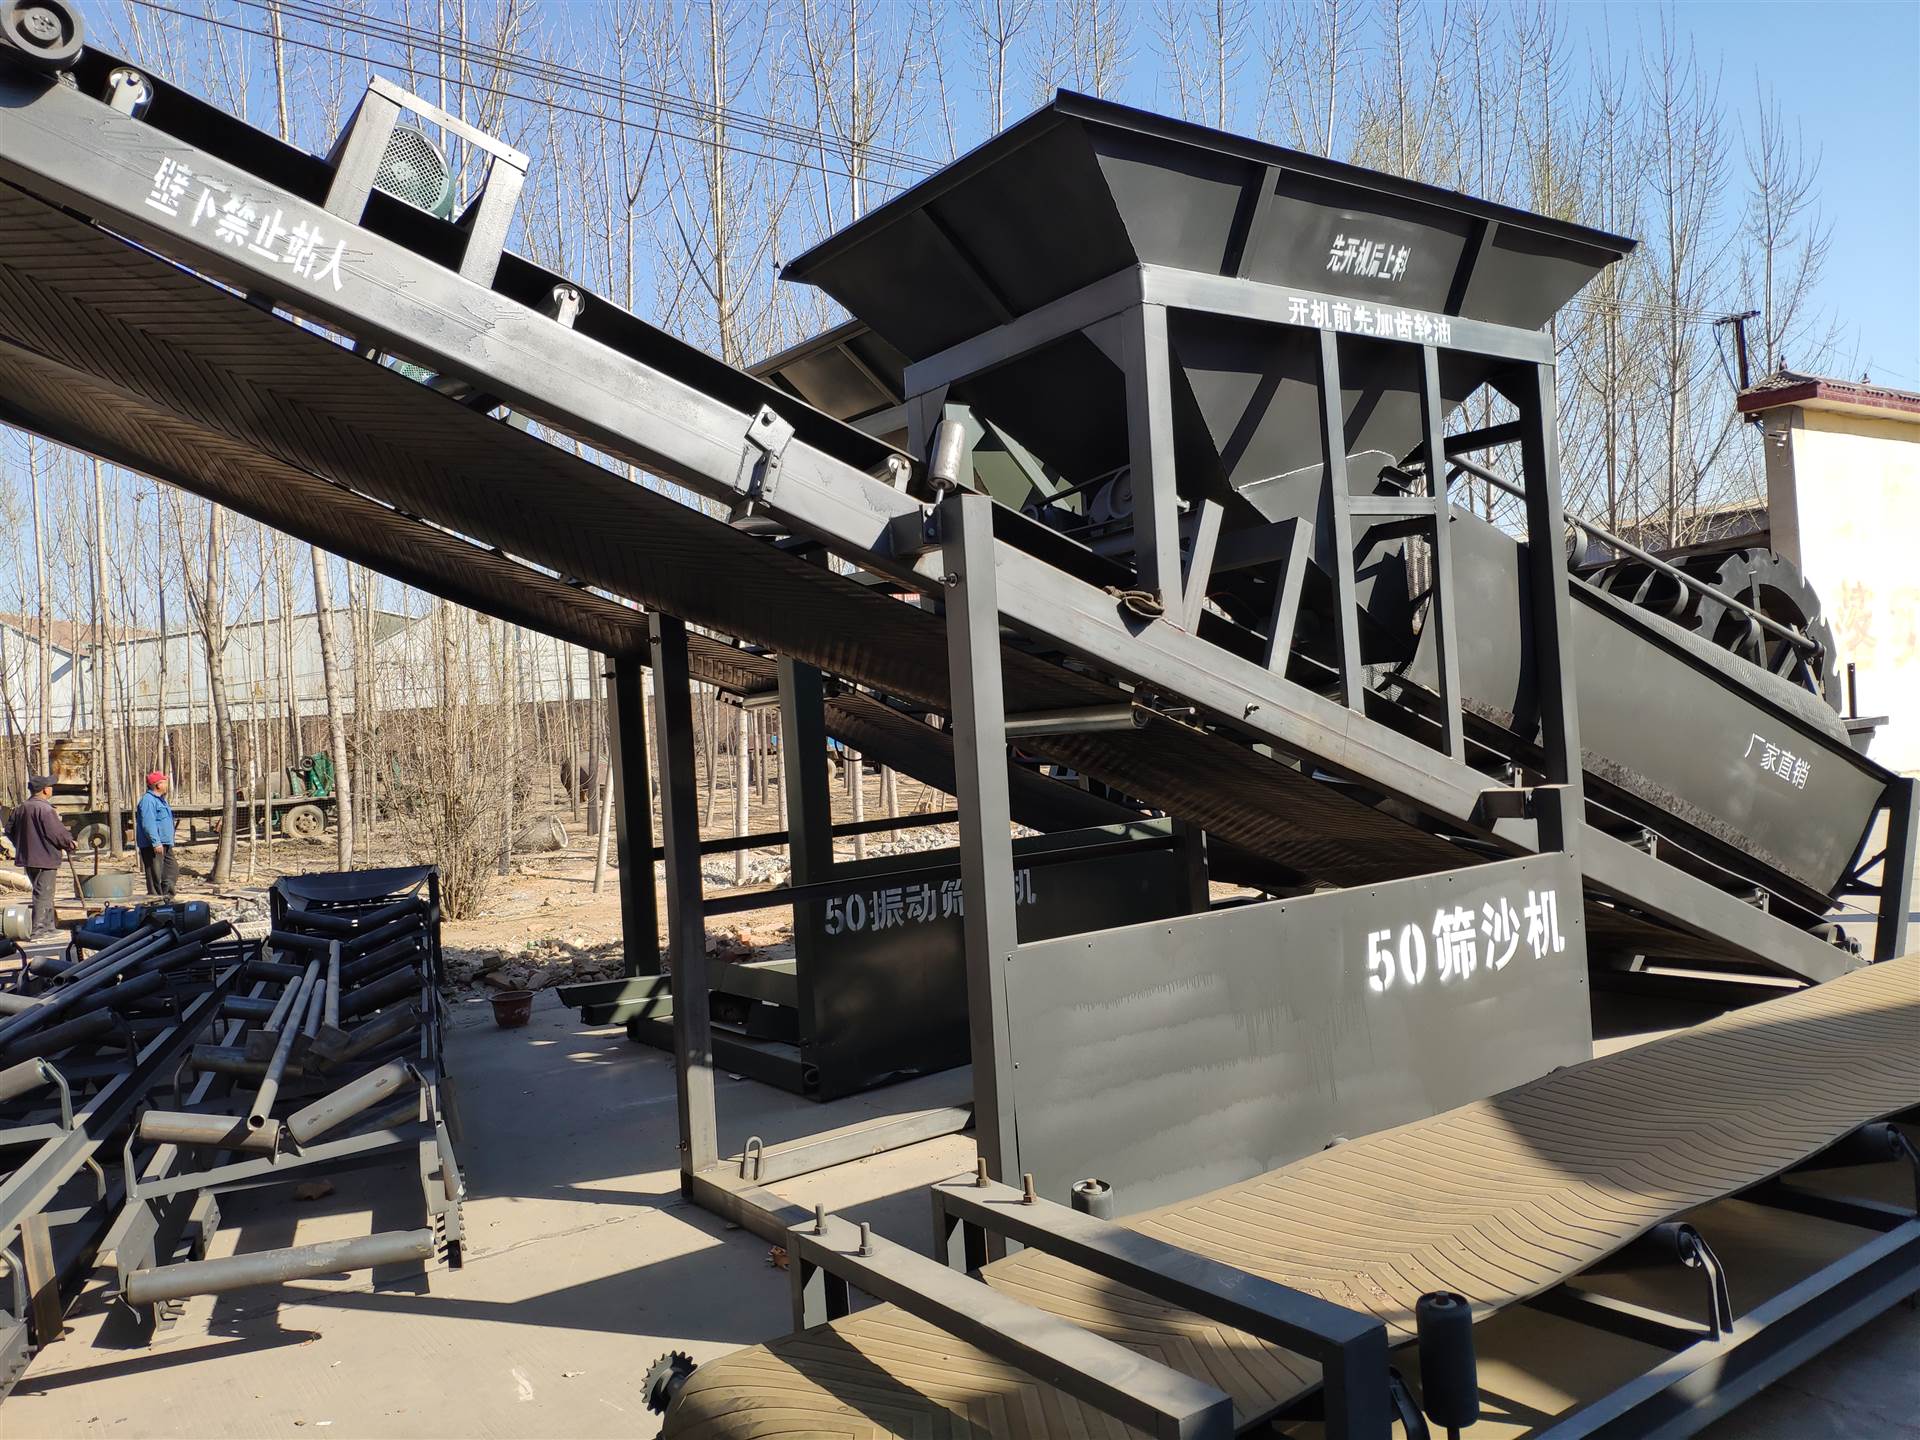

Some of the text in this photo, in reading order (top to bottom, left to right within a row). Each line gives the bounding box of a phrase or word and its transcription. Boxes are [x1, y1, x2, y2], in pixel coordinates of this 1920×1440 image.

[1288, 297, 1451, 344] 开机前先加齿轮油
[1745, 733, 1811, 789] 厂家直销
[825, 868, 1037, 935] 50振动筛机
[1367, 890, 1566, 992] 50筛沙机
